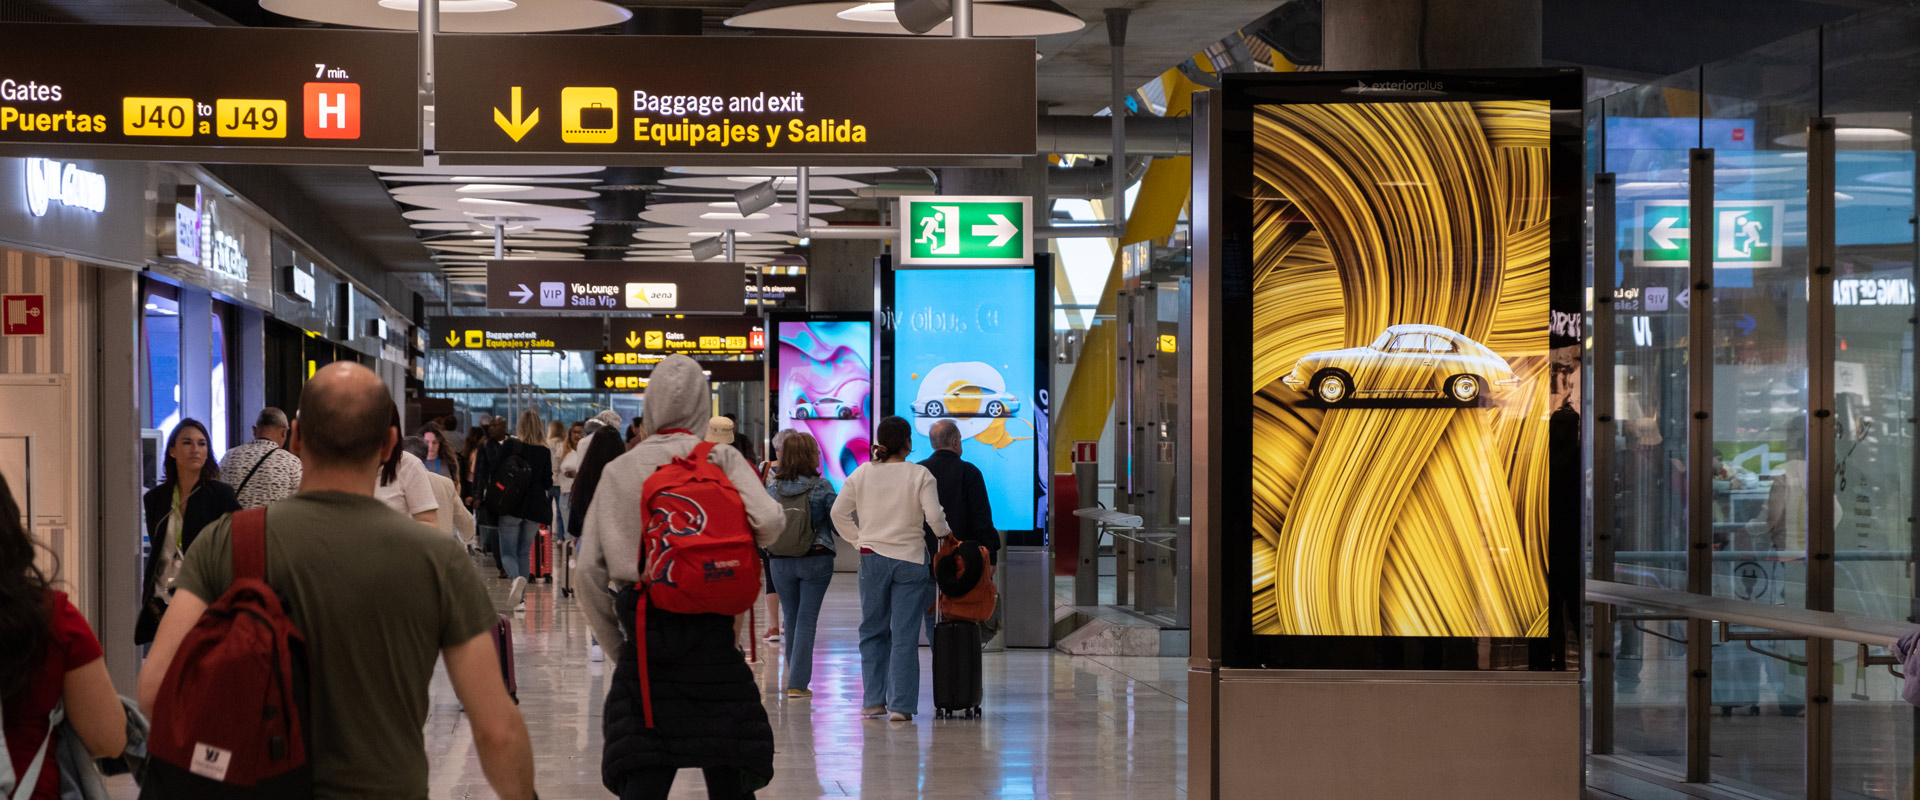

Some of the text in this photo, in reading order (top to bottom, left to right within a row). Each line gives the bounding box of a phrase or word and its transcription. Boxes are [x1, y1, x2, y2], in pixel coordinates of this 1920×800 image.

[315, 63, 349, 79] 7 min.
[0, 79, 62, 101] Gates
[1372, 79, 1443, 91] exteriorplus
[633, 90, 804, 116] Baggage and exit
[131, 102, 279, 131] J40 to J49
[318, 93, 346, 129] H
[0, 107, 211, 134] Puertas a
[633, 118, 867, 147] Equipajes y Salida
[543, 289, 562, 299] VIP
[571, 283, 619, 295] Vip Lounge
[571, 295, 616, 308] Sala Vip
[665, 332, 684, 340] Gates
[702, 338, 718, 346] J40
[728, 338, 744, 346] J49
[754, 335, 763, 346] H
[486, 340, 523, 348] Equipajes
[531, 339, 554, 348] Salida
[665, 340, 696, 348] Puertas
